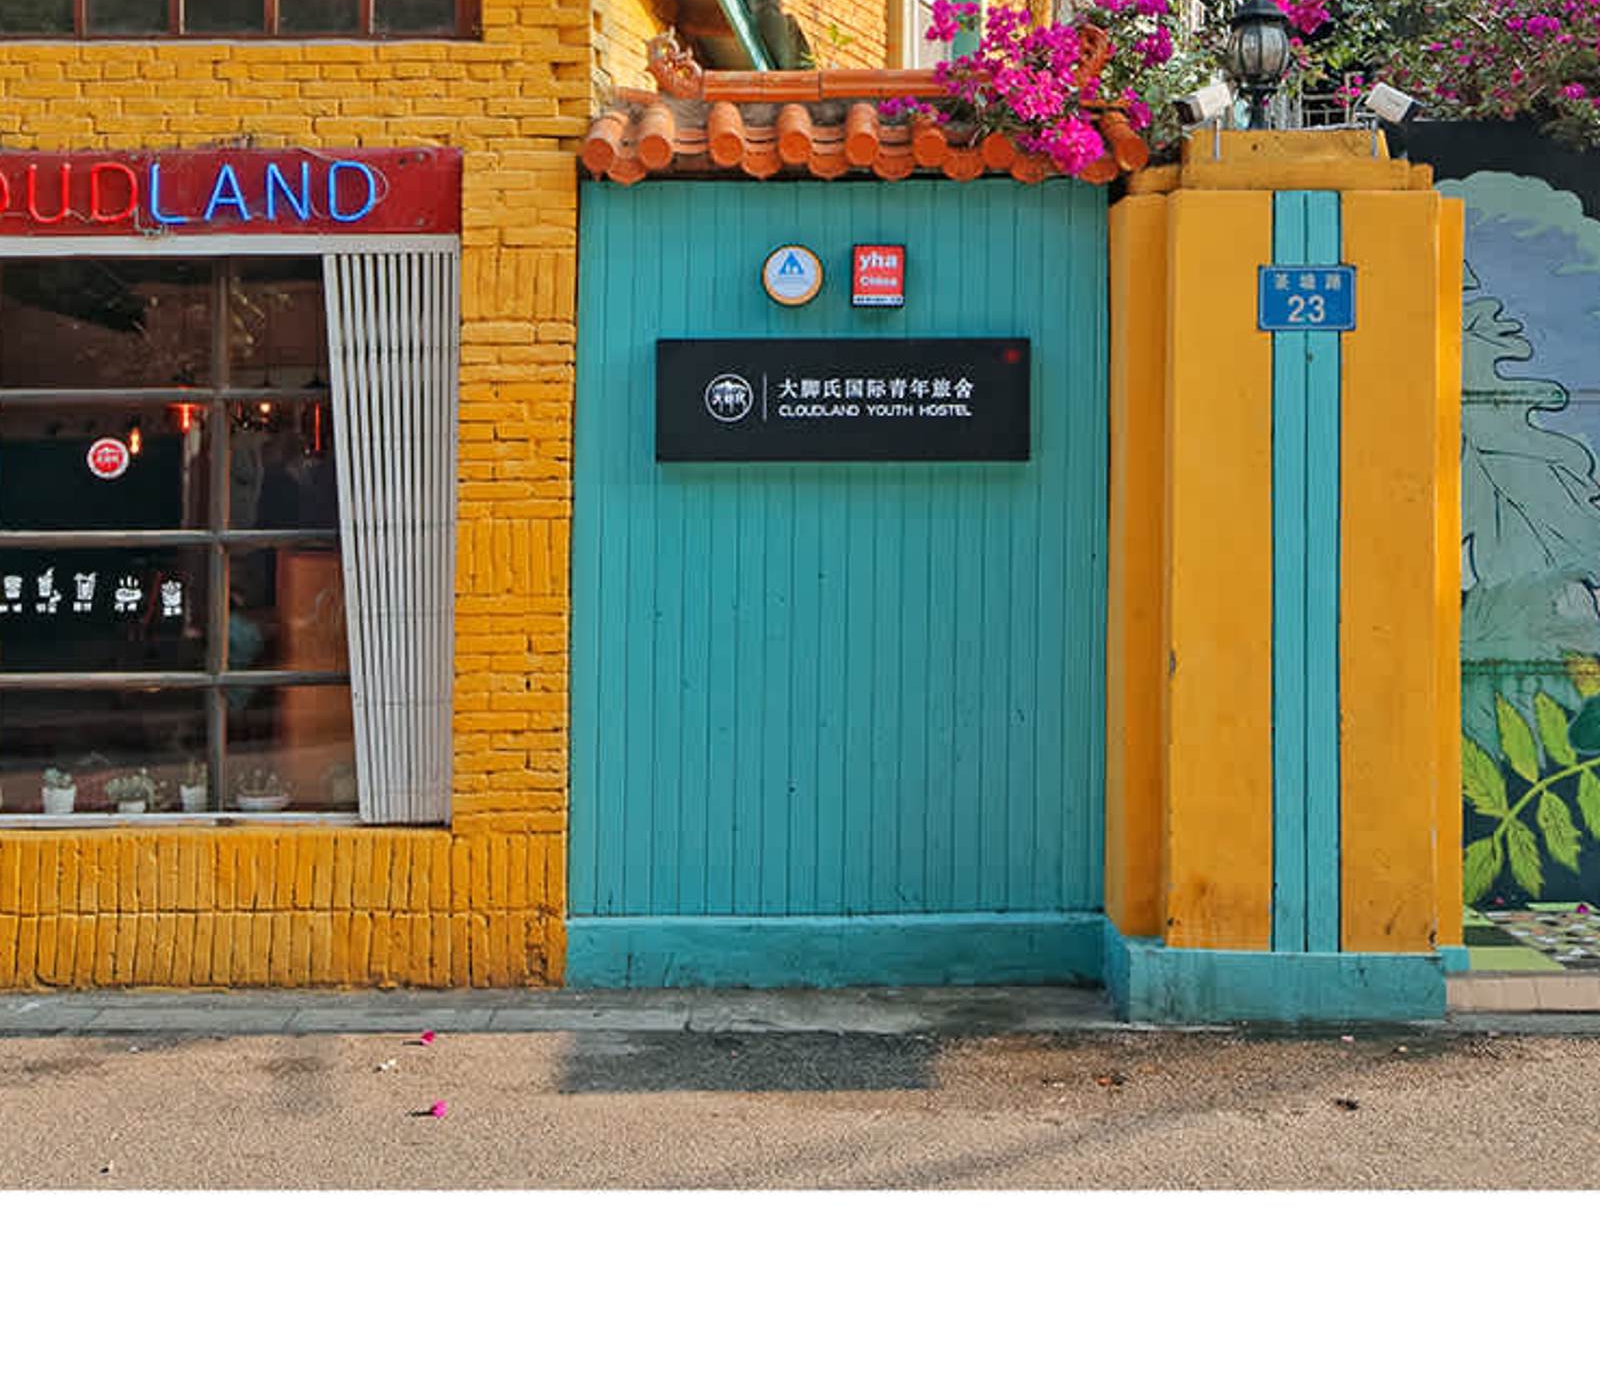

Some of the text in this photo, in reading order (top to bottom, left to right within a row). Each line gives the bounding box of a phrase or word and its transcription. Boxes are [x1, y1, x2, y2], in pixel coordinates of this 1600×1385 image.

[0, 161, 377, 224] UDLAND
[860, 249, 897, 272] yha
[1287, 294, 1325, 323] 23
[778, 377, 974, 399] 大脚氏国际青年旅舍
[778, 403, 973, 417] CLOUDLAND YOUTH HOSTEL
